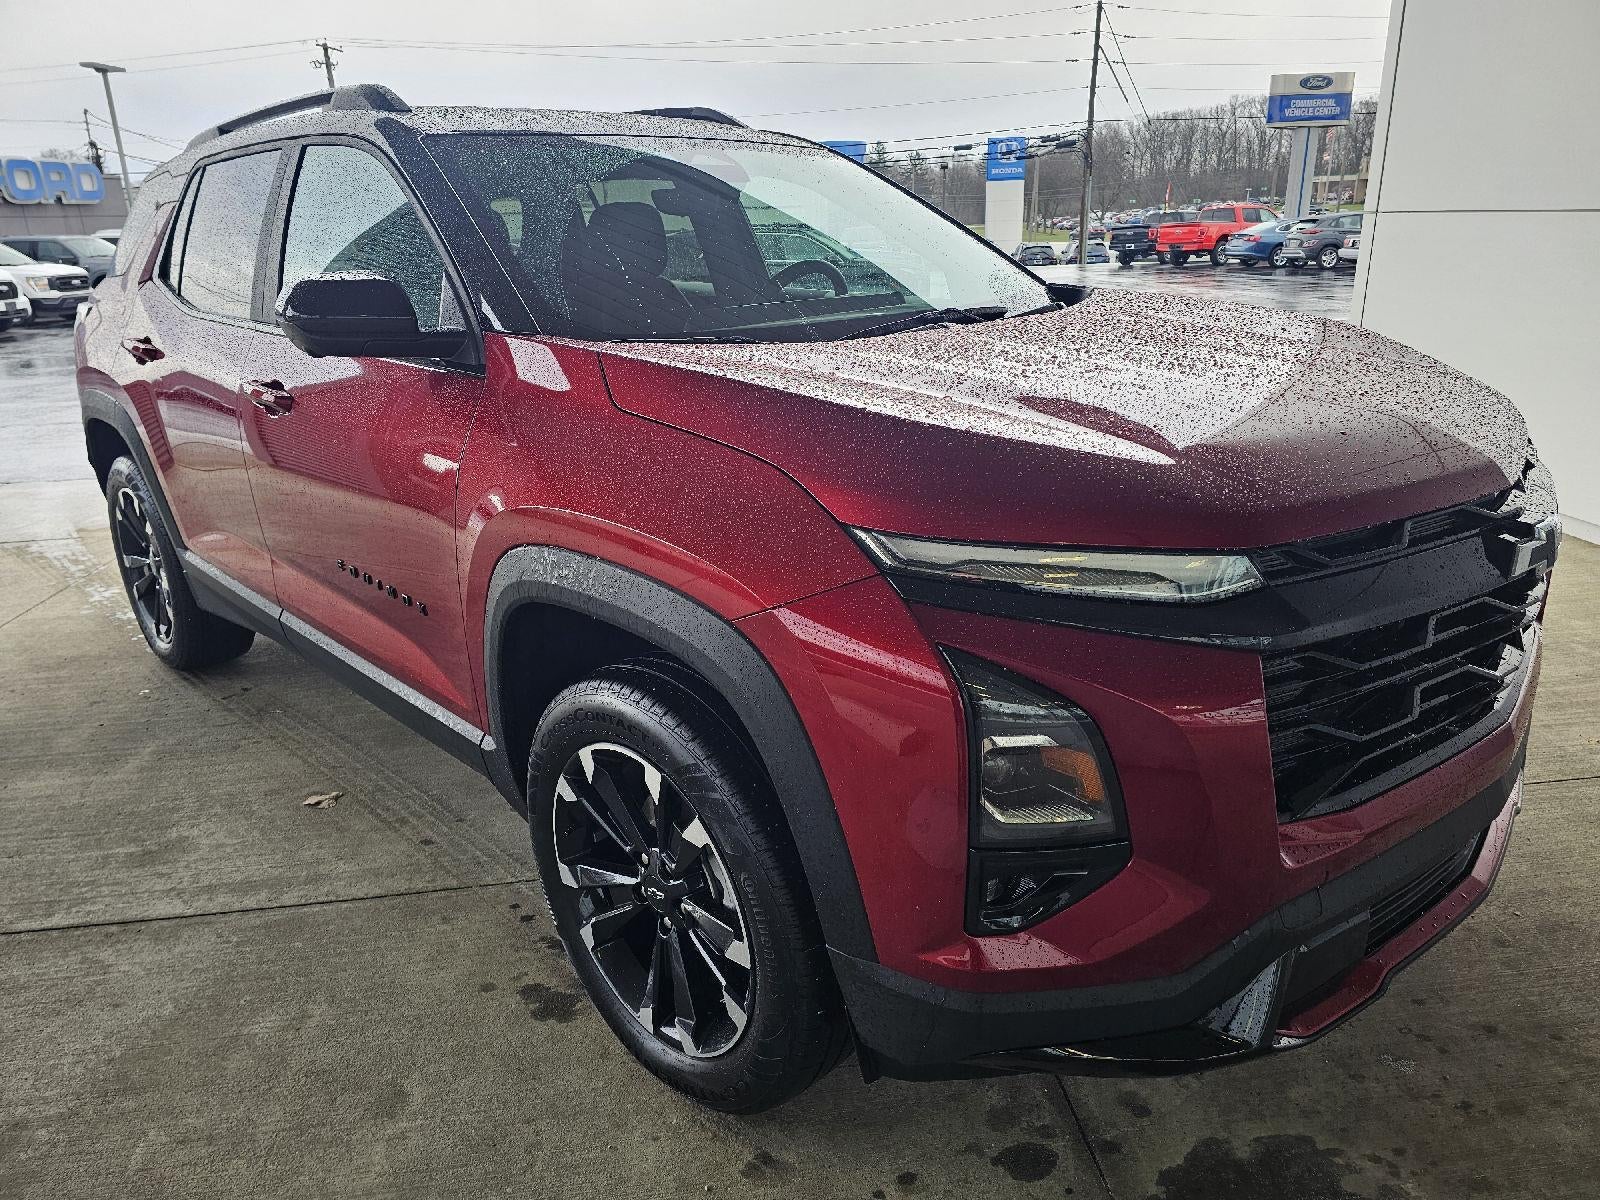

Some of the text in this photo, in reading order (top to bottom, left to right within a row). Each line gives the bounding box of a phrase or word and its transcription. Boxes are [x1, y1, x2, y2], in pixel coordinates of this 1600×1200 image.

[1290, 98, 1336, 108] COMMERCIAL
[1284, 105, 1340, 116] VEHICLE CENTER
[991, 167, 1024, 175] HONDA
[0, 158, 105, 203] ORD
